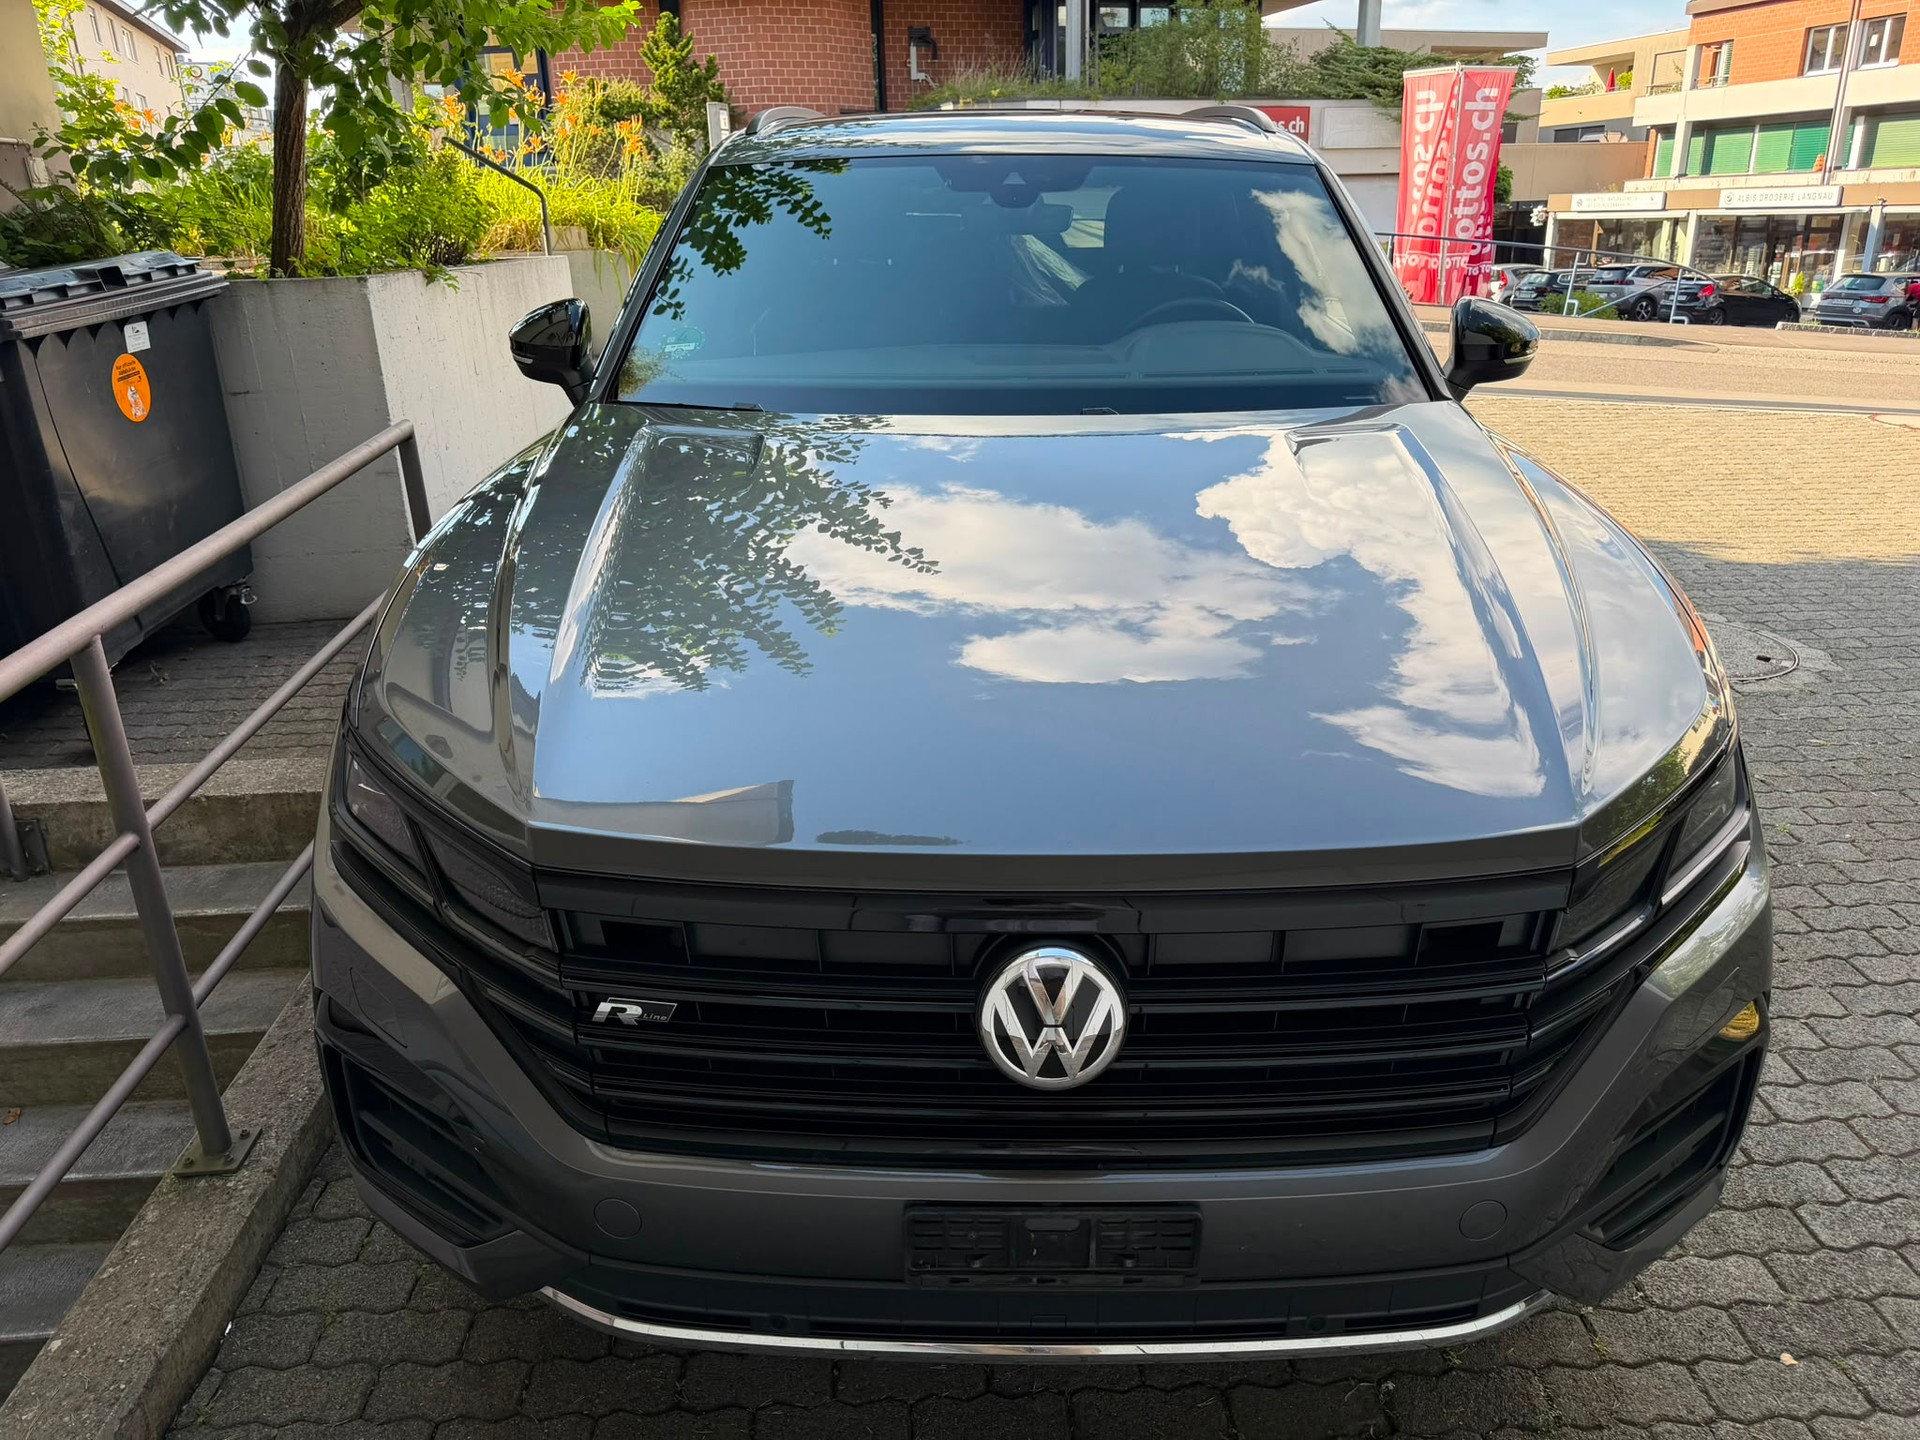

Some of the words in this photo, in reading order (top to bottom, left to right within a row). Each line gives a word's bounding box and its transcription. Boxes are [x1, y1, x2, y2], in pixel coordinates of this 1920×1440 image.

[1454, 87, 1499, 240] ottos.ch
[1736, 193, 1757, 203] ALBIS
[1759, 192, 1795, 202] DROGERIE
[1797, 191, 1833, 201] LANGNAU
[591, 1001, 643, 1026] R
[643, 1013, 668, 1021] Line
[983, 949, 1123, 1089] VW
